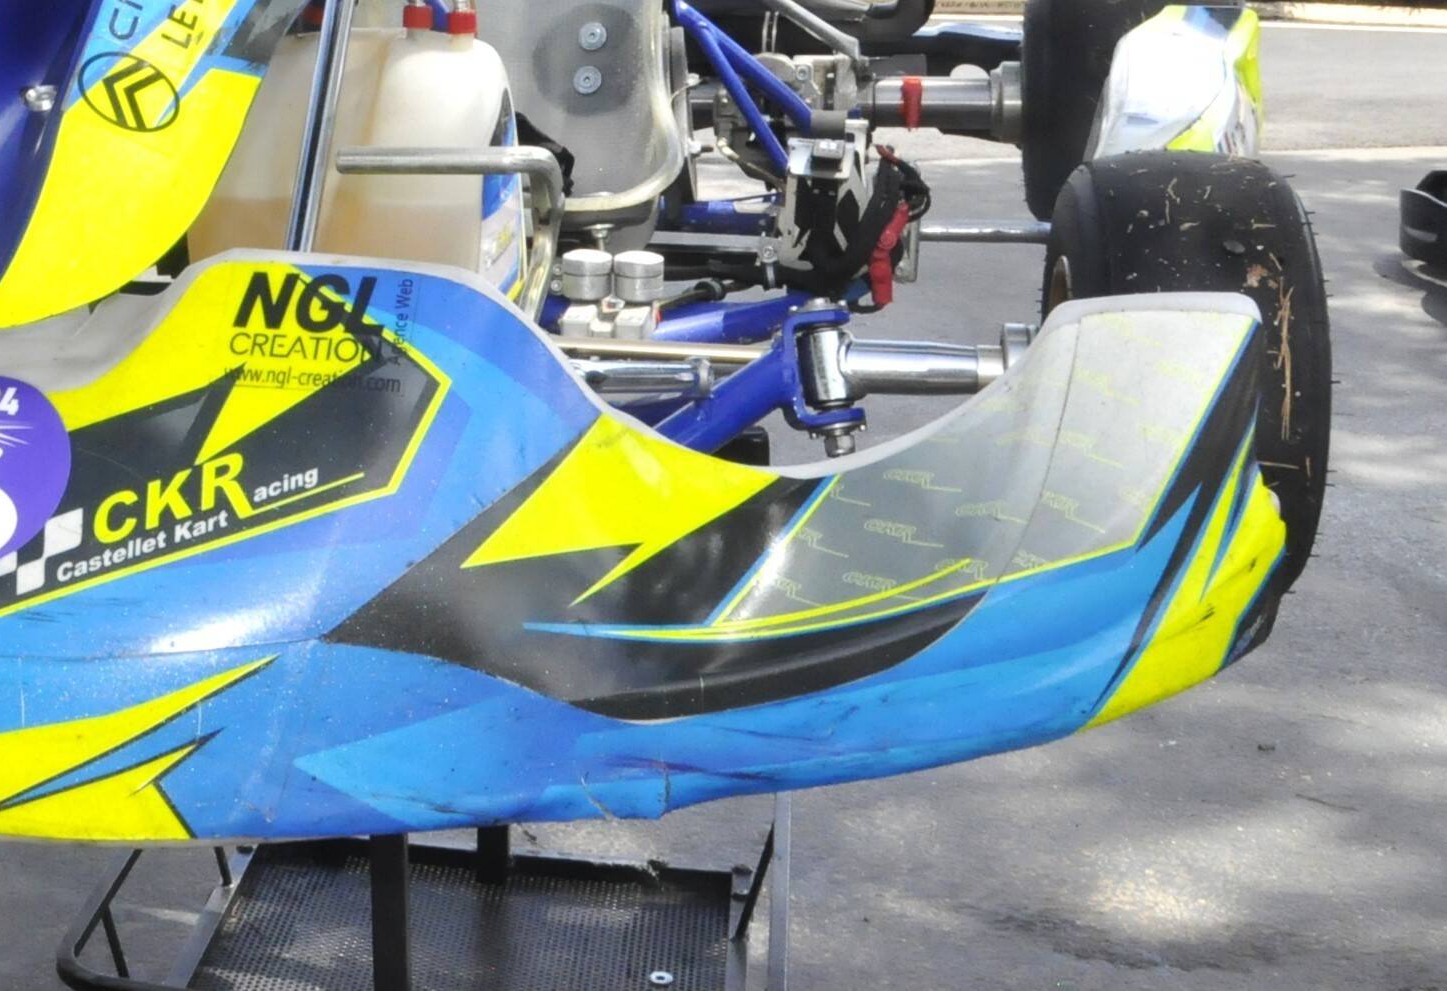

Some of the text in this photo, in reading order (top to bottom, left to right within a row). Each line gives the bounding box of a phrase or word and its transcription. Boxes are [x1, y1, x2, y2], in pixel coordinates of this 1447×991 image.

[230, 332, 383, 364] CREATION
[233, 272, 385, 335] NGL
[391, 278, 414, 367] Aence Web
[57, 468, 319, 583] Castellet Kart acing
[93, 452, 254, 544] CKR
